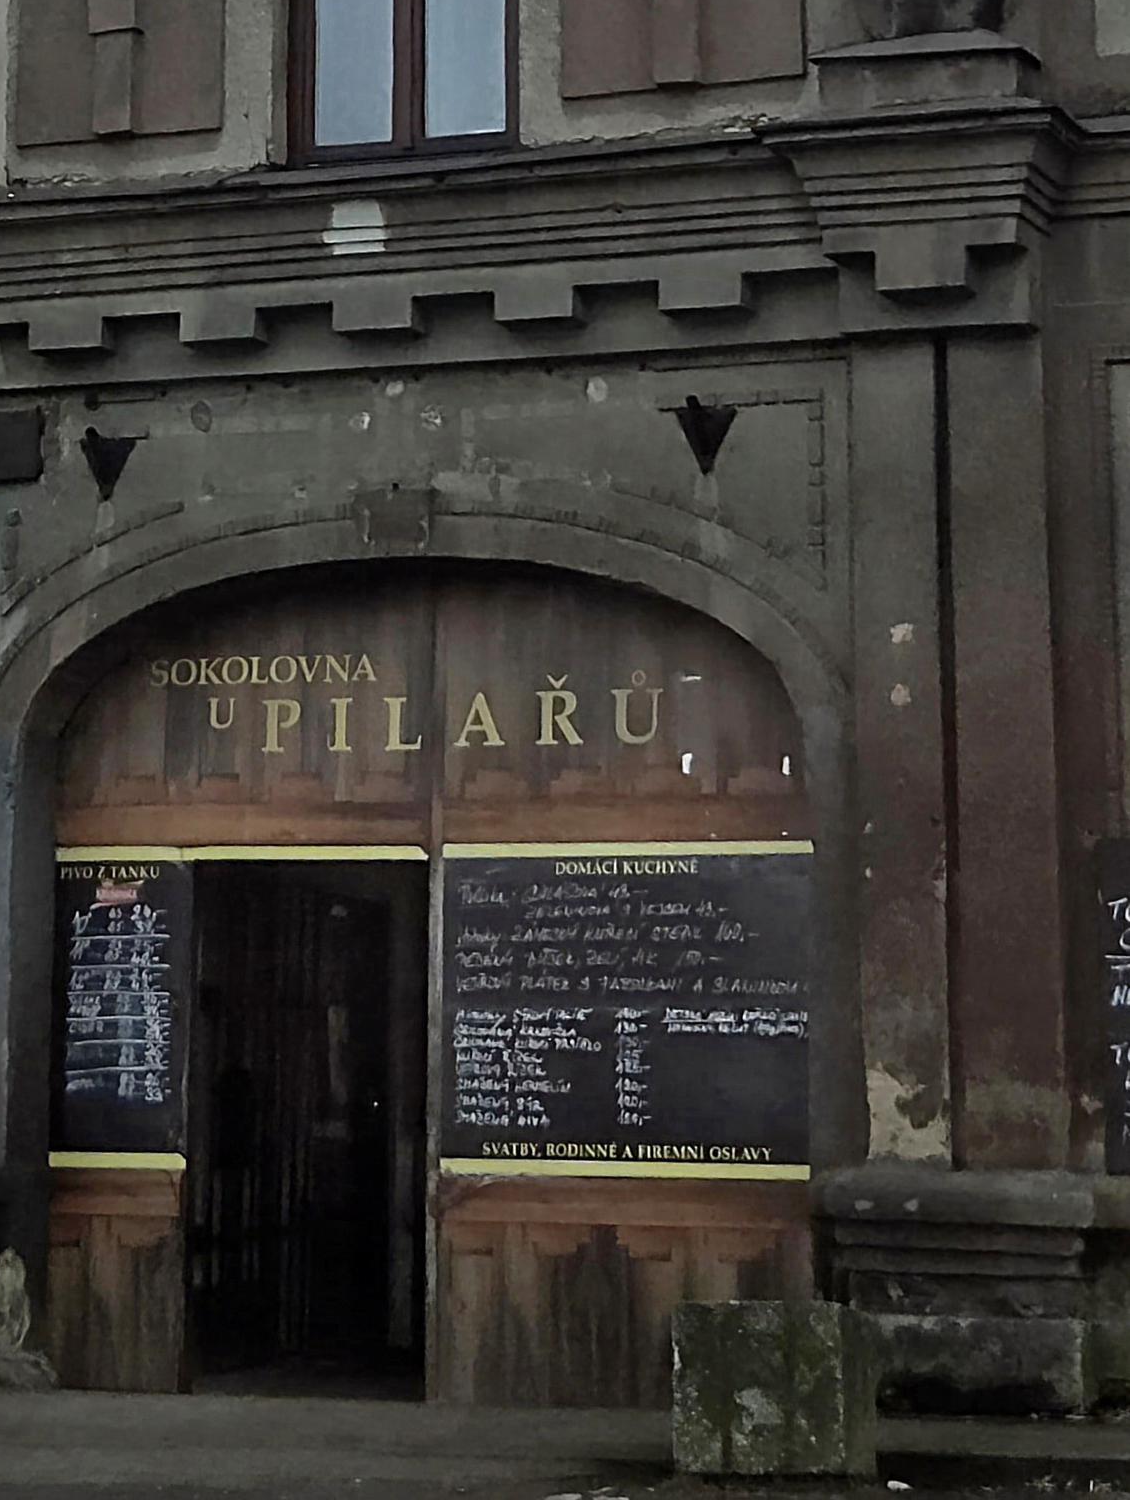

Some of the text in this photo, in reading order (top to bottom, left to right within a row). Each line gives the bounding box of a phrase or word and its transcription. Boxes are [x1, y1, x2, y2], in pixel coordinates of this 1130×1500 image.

[149, 653, 378, 689] SOKOLOVNA
[208, 669, 665, 754] U PILAŘŮ
[59, 865, 93, 880] PIVO
[110, 865, 161, 880] TANKU
[554, 858, 618, 876] DOMÁCÍ
[545, 1141, 618, 1160] RODINNÉ
[621, 1145, 634, 1160] A
[638, 1142, 704, 1161] FIREMNÍ
[708, 1145, 773, 1162] OSLAVY
